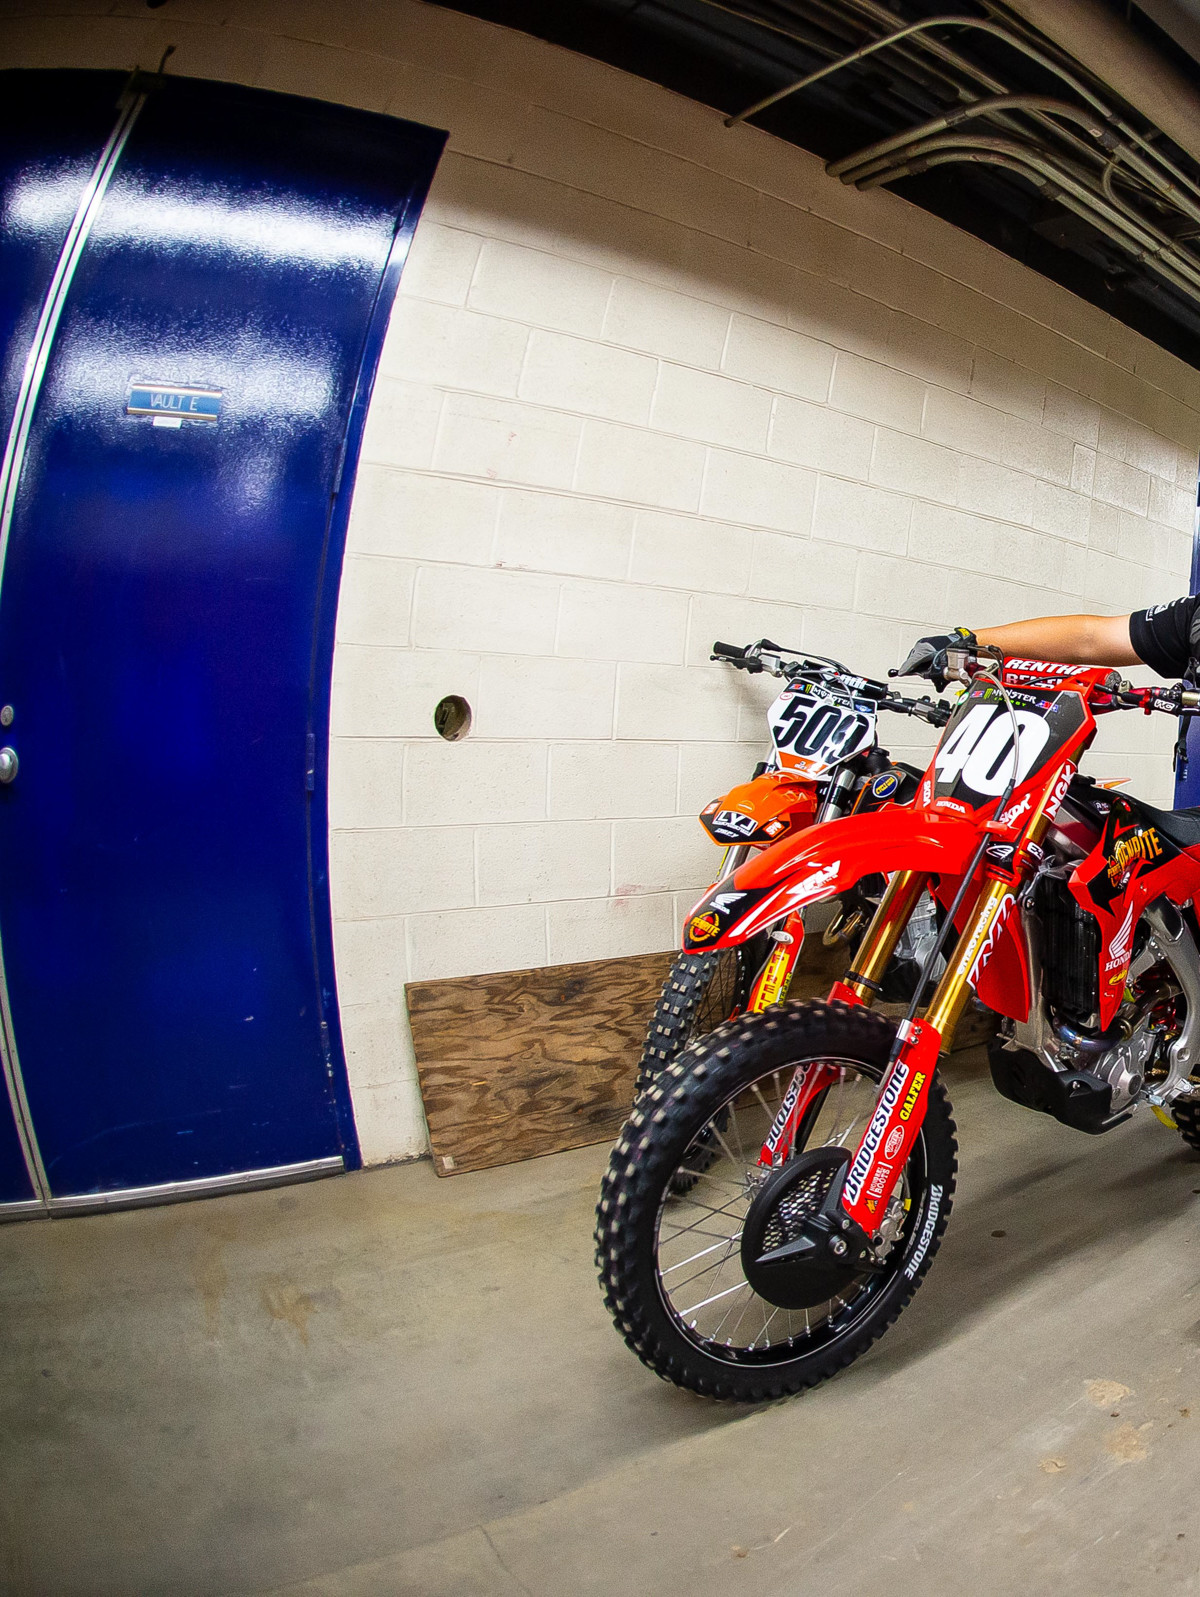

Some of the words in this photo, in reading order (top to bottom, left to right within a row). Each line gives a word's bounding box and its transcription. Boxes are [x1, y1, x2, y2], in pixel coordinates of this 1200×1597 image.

[150, 393, 187, 410] VAULT
[189, 396, 200, 411] E
[934, 703, 1051, 797] 40
[1046, 764, 1076, 818] NGK
[690, 916, 721, 937] PENRITE
[758, 953, 786, 1013] PIRELL
[777, 971, 793, 1008] ALFER
[899, 1071, 926, 1121] GALFER
[843, 1059, 908, 1208] BRIDGESTONE
[874, 1168, 891, 1194] BOOTS
[905, 1184, 943, 1281] BRIDGESTONE
